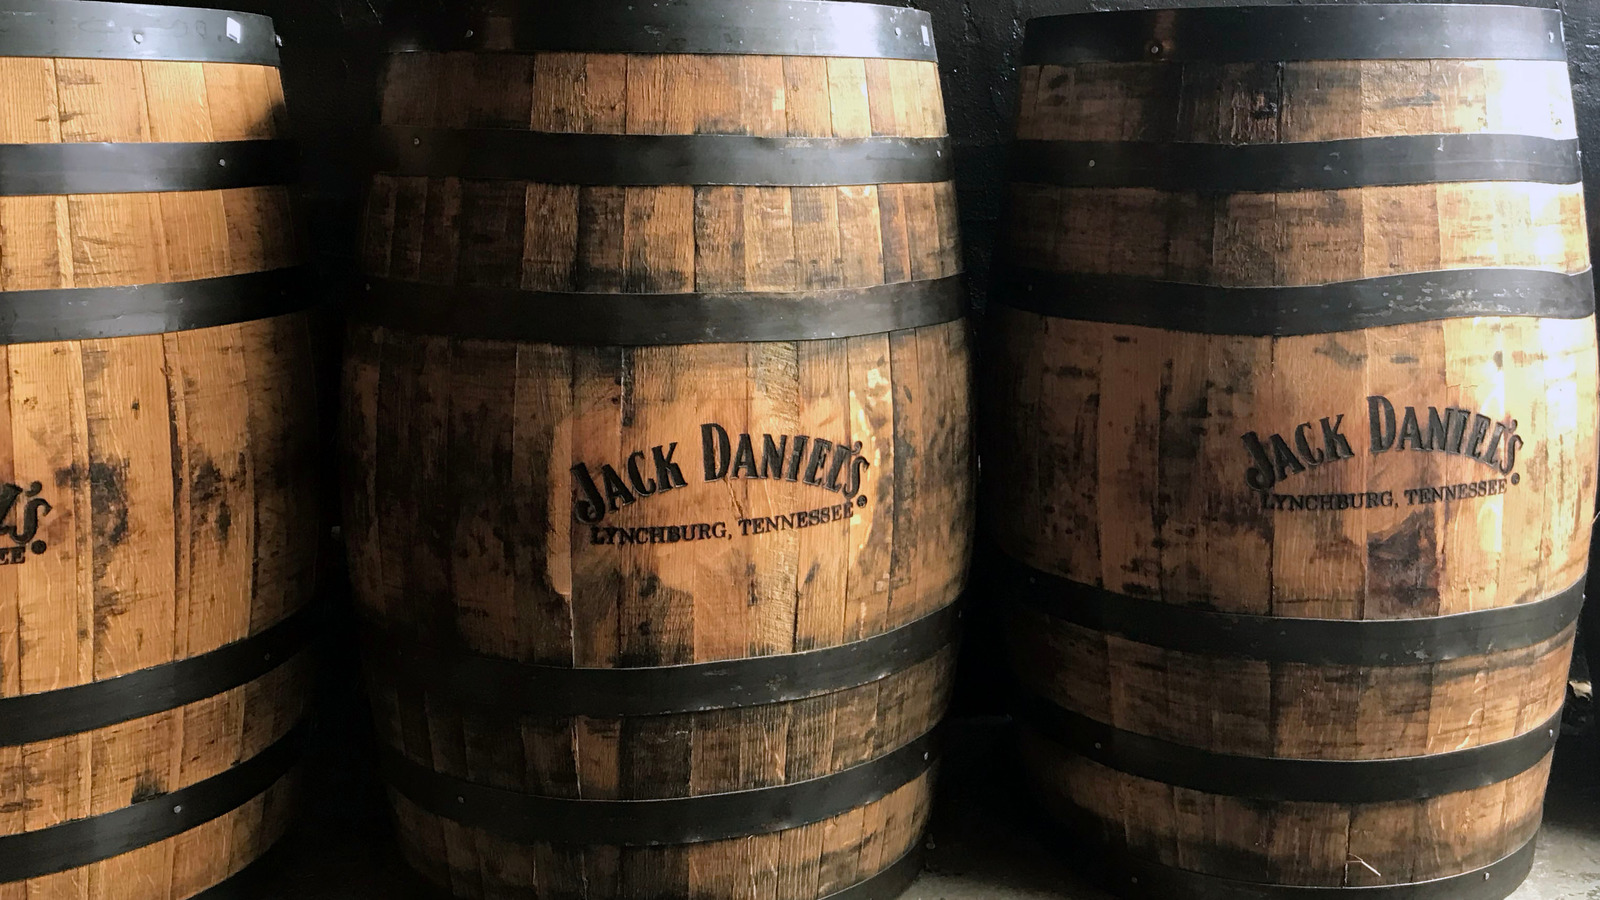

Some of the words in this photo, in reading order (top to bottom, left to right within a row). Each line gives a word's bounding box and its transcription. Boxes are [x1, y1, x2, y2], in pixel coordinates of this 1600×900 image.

[570, 441, 688, 524] JACK
[700, 422, 870, 499] DANIEL'S
[1240, 413, 1355, 491] JACK
[1366, 394, 1524, 476] DANIEL'S
[590, 521, 733, 546] LYNCHBURG,
[738, 502, 854, 537] TENNESSEE
[1260, 490, 1399, 512] LYNCHBURG,
[1404, 478, 1508, 506] TENNESSEE
